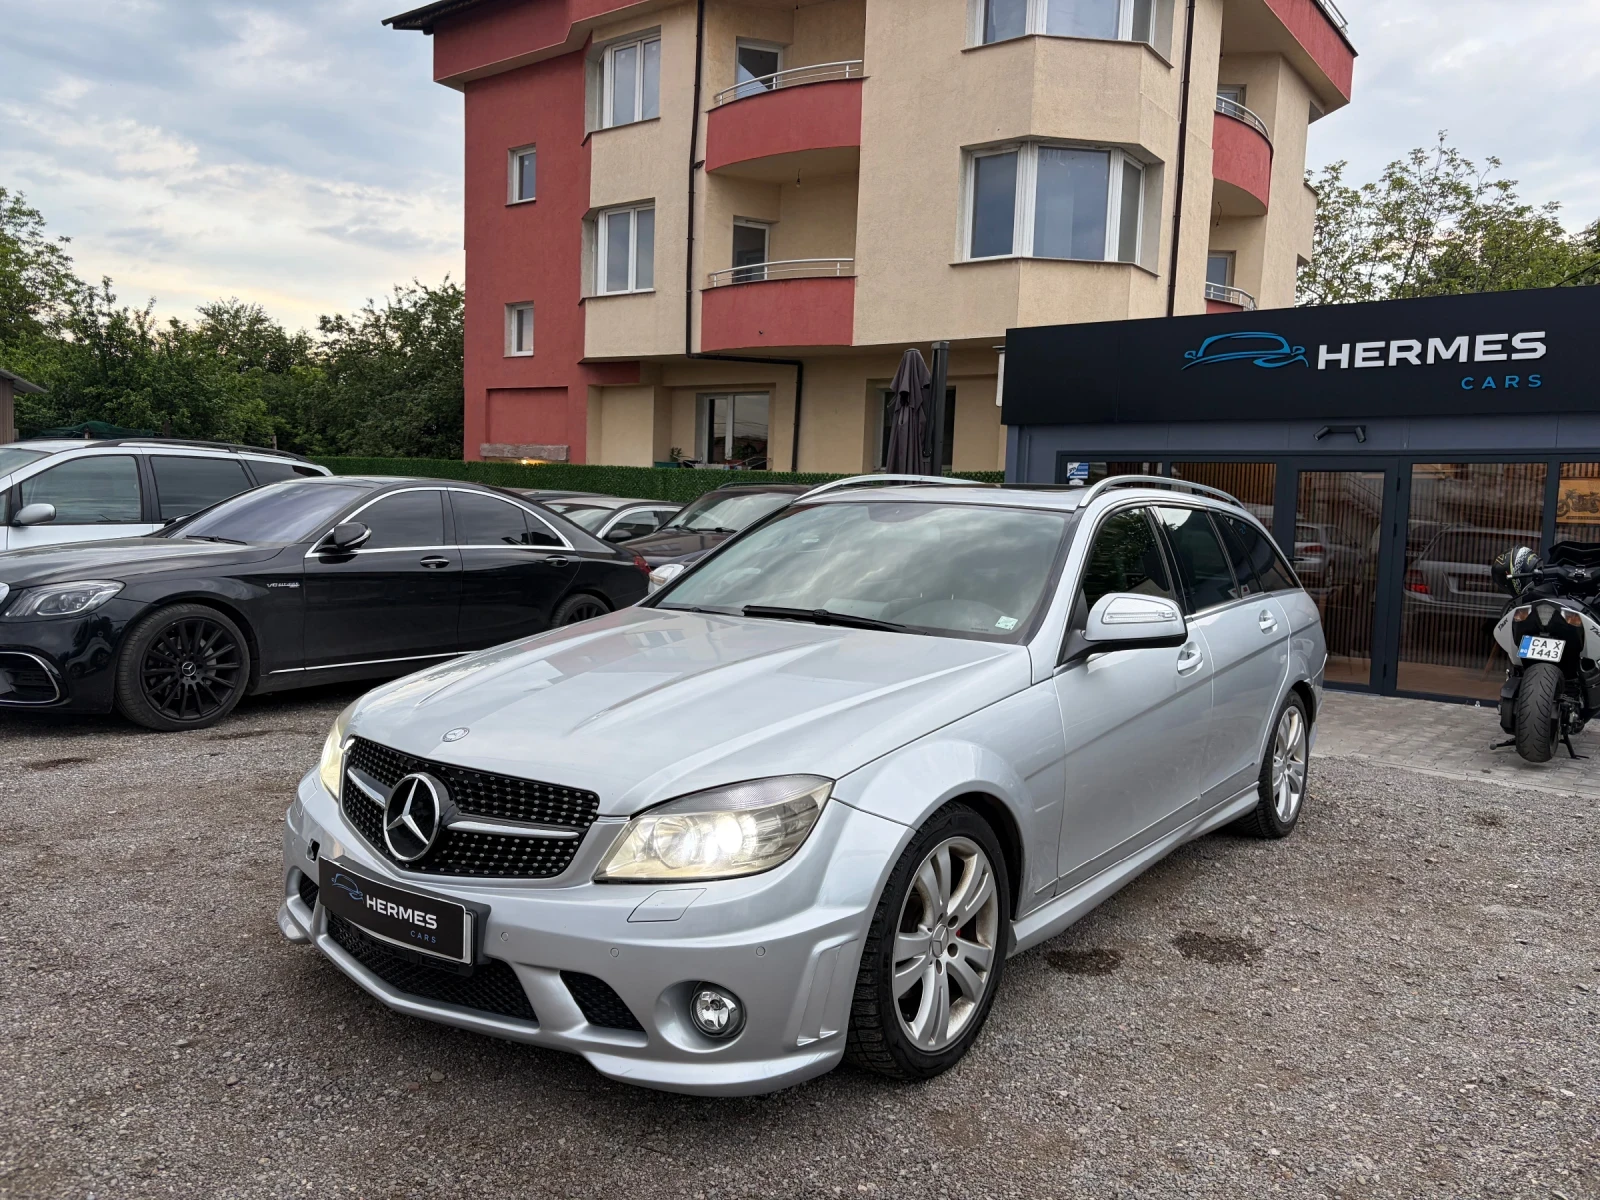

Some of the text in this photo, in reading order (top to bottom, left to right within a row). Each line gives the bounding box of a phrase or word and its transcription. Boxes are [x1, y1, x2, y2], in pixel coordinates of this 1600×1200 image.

[1317, 331, 1547, 370] HERMES
[1461, 374, 1542, 390] CARS
[1531, 639, 1562, 651] CA X
[1530, 647, 1559, 659] 1443
[366, 894, 438, 930] HERMES
[410, 930, 437, 944] CARS
